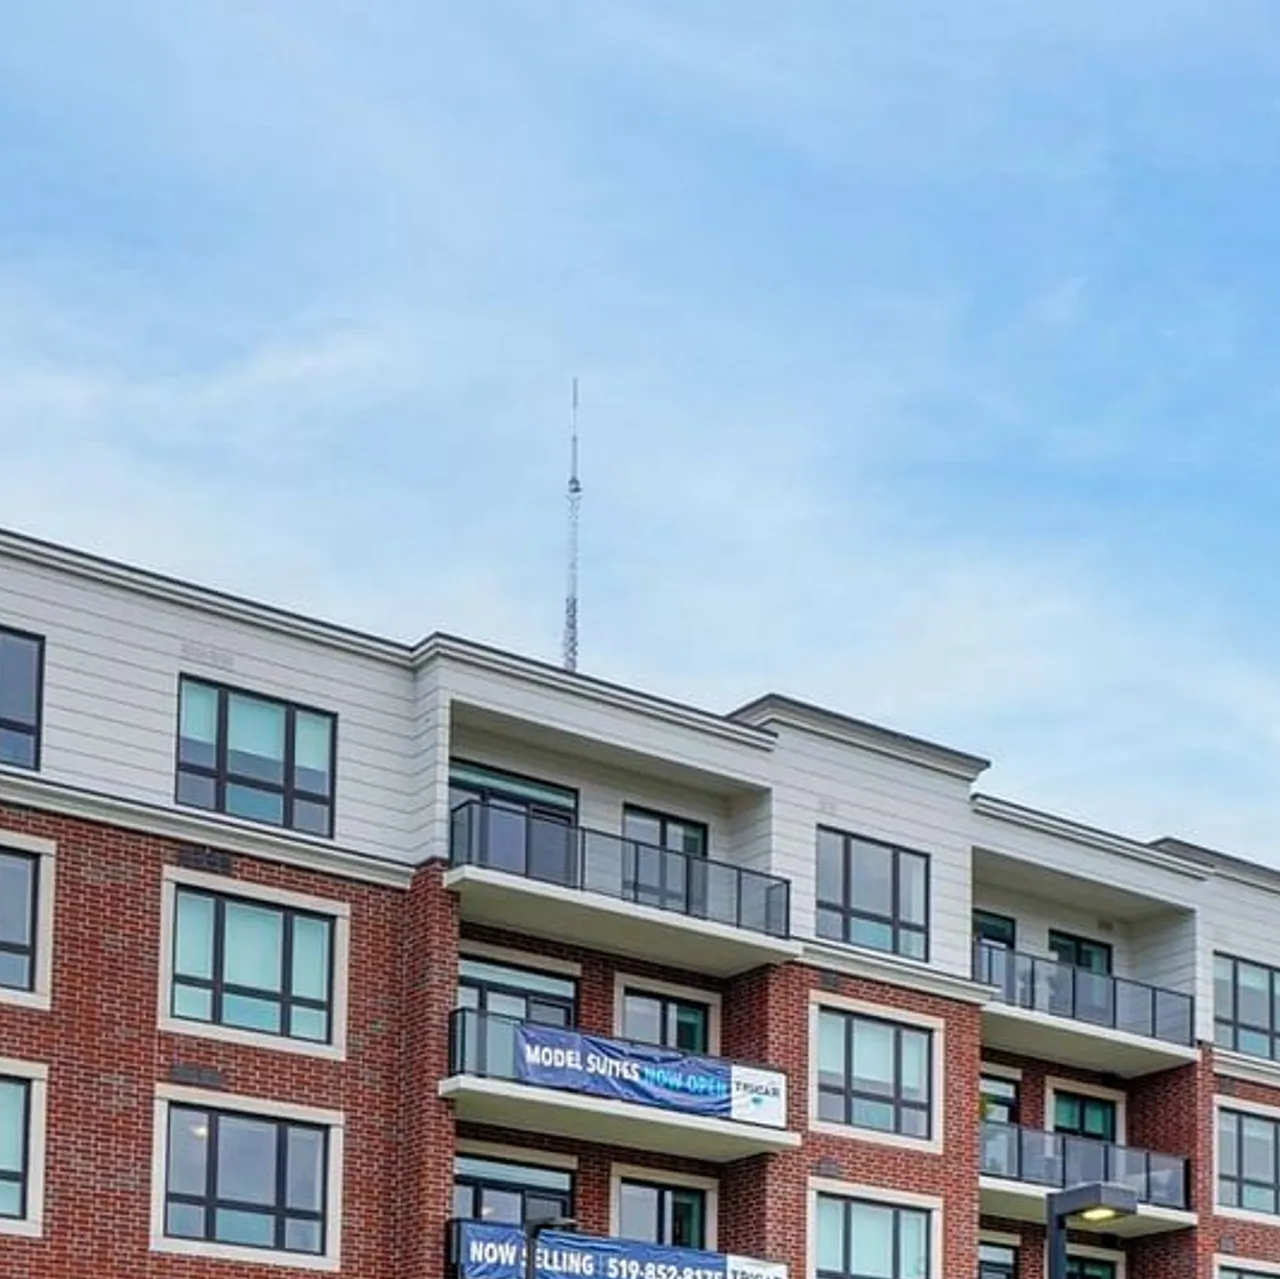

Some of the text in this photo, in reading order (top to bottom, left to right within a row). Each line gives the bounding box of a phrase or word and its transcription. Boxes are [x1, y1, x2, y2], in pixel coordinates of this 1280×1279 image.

[525, 1044, 583, 1073] MODEL
[586, 1054, 640, 1080] SUITES
[470, 1241, 516, 1266] NOW
